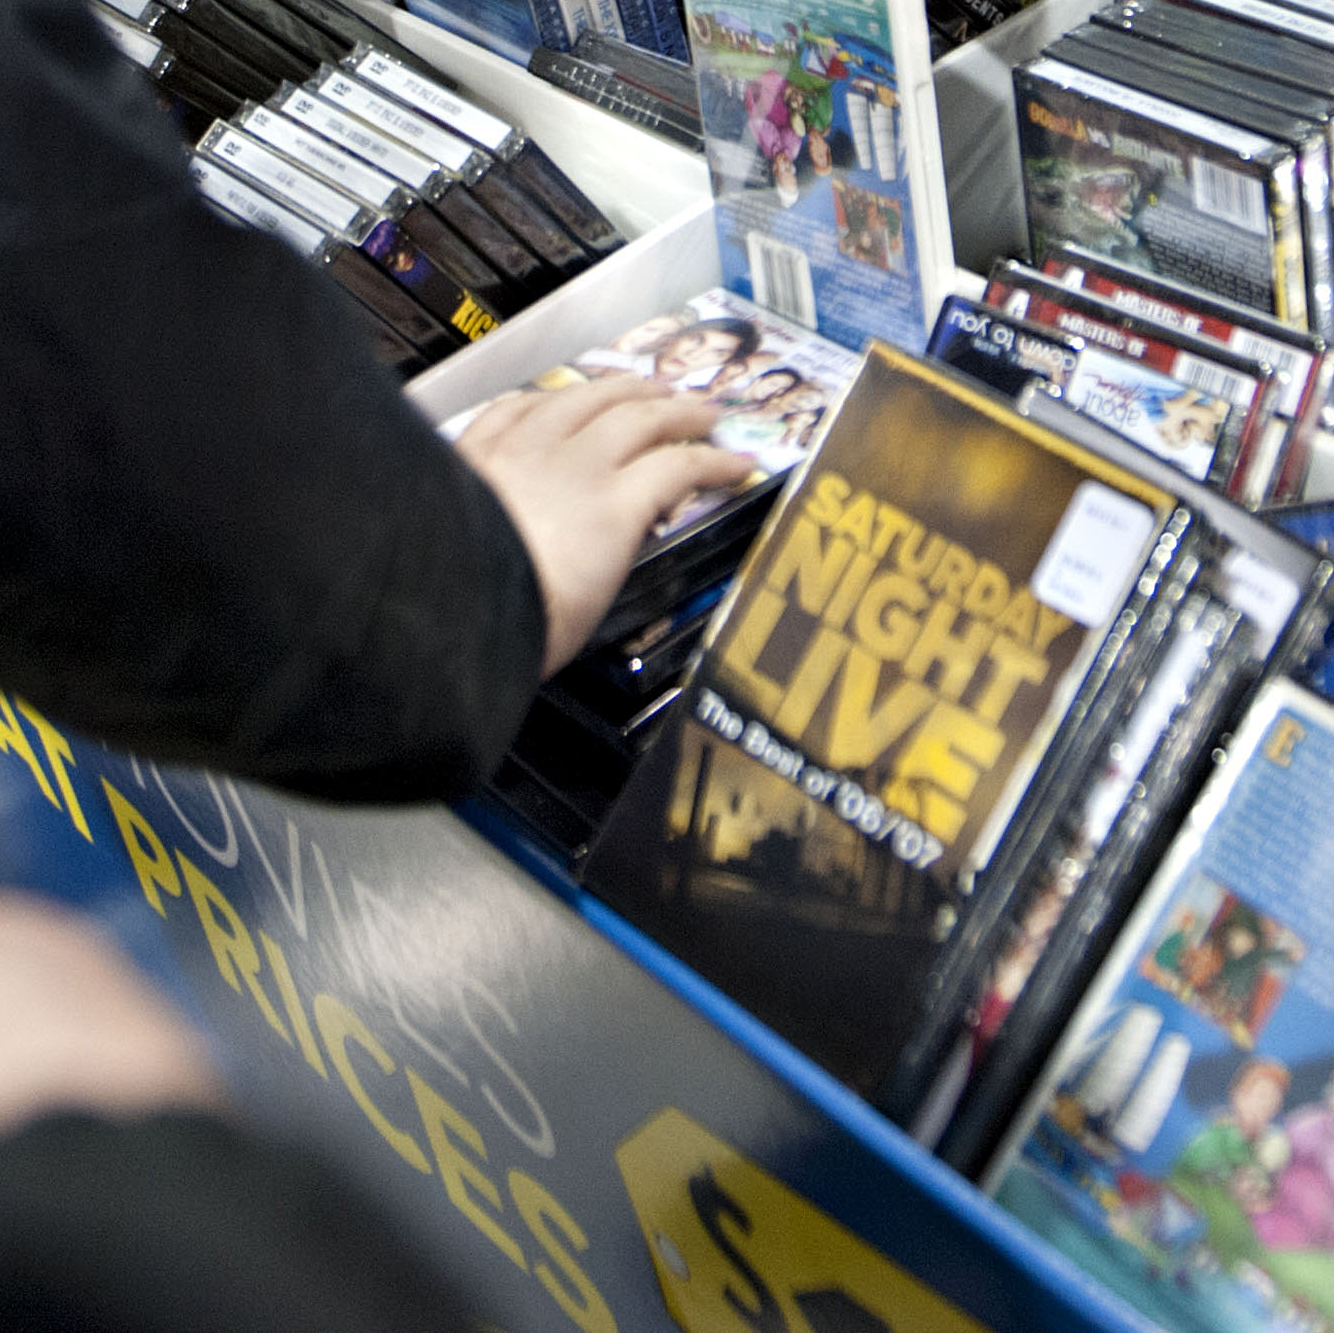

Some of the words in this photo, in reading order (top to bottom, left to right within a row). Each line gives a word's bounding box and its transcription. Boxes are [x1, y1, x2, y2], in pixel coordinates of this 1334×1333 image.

[452, 293, 502, 343] KIC
[950, 308, 992, 339] you
[1058, 312, 1126, 349] MASTERS
[1114, 288, 1180, 328] MASTERS
[990, 324, 1017, 352] to
[1017, 334, 1078, 372] down
[1083, 389, 1142, 428] about
[806, 471, 1076, 654] SATURDAY
[768, 518, 1049, 730] NIGHT
[720, 593, 1008, 846] LIVE
[695, 692, 744, 744] The
[739, 724, 804, 778] Best
[800, 762, 835, 805] of
[99, 774, 619, 1333] PRICES
